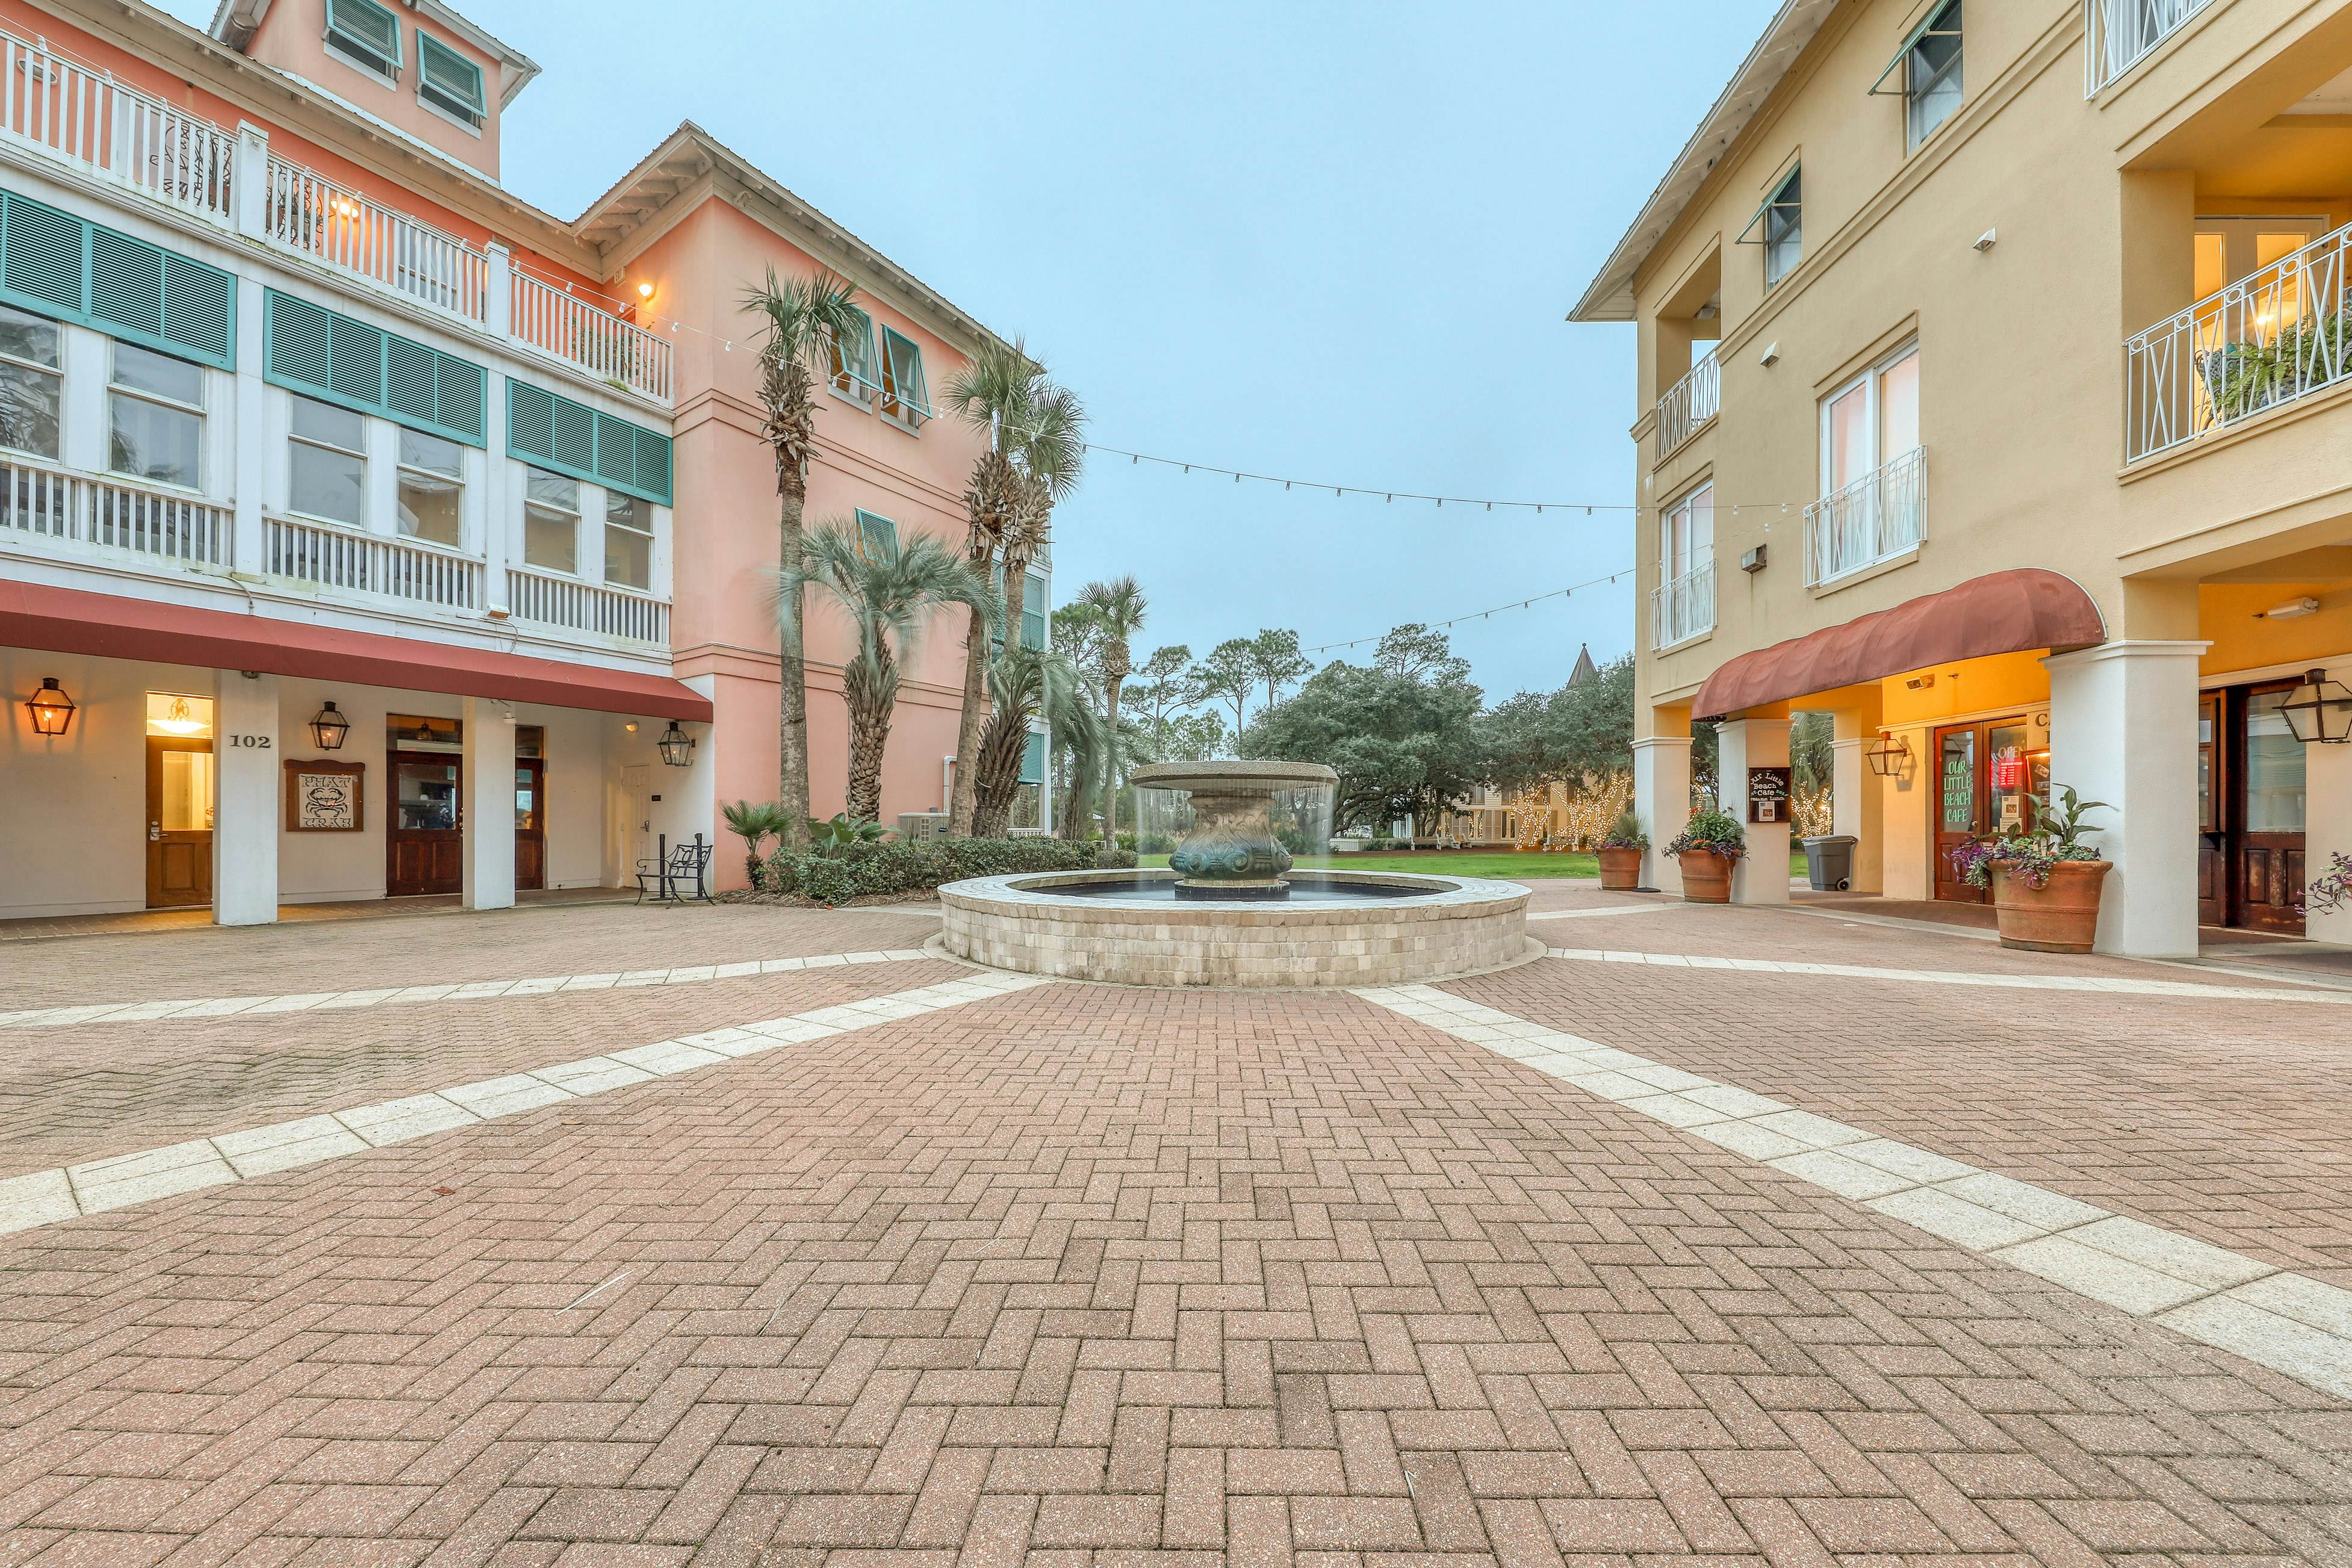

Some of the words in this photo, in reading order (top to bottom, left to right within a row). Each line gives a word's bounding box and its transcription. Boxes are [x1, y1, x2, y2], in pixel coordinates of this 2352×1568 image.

[230, 735, 271, 748] 102
[1999, 746, 2025, 759] OPEN
[1948, 760, 1967, 775] OUR
[300, 775, 352, 787] PHAT
[1765, 773, 1784, 786] Little
[1944, 775, 1972, 790] LITTLE
[1944, 792, 1972, 806] BEACH
[1947, 808, 1968, 823] CAFE
[303, 817, 351, 828] CRAB
